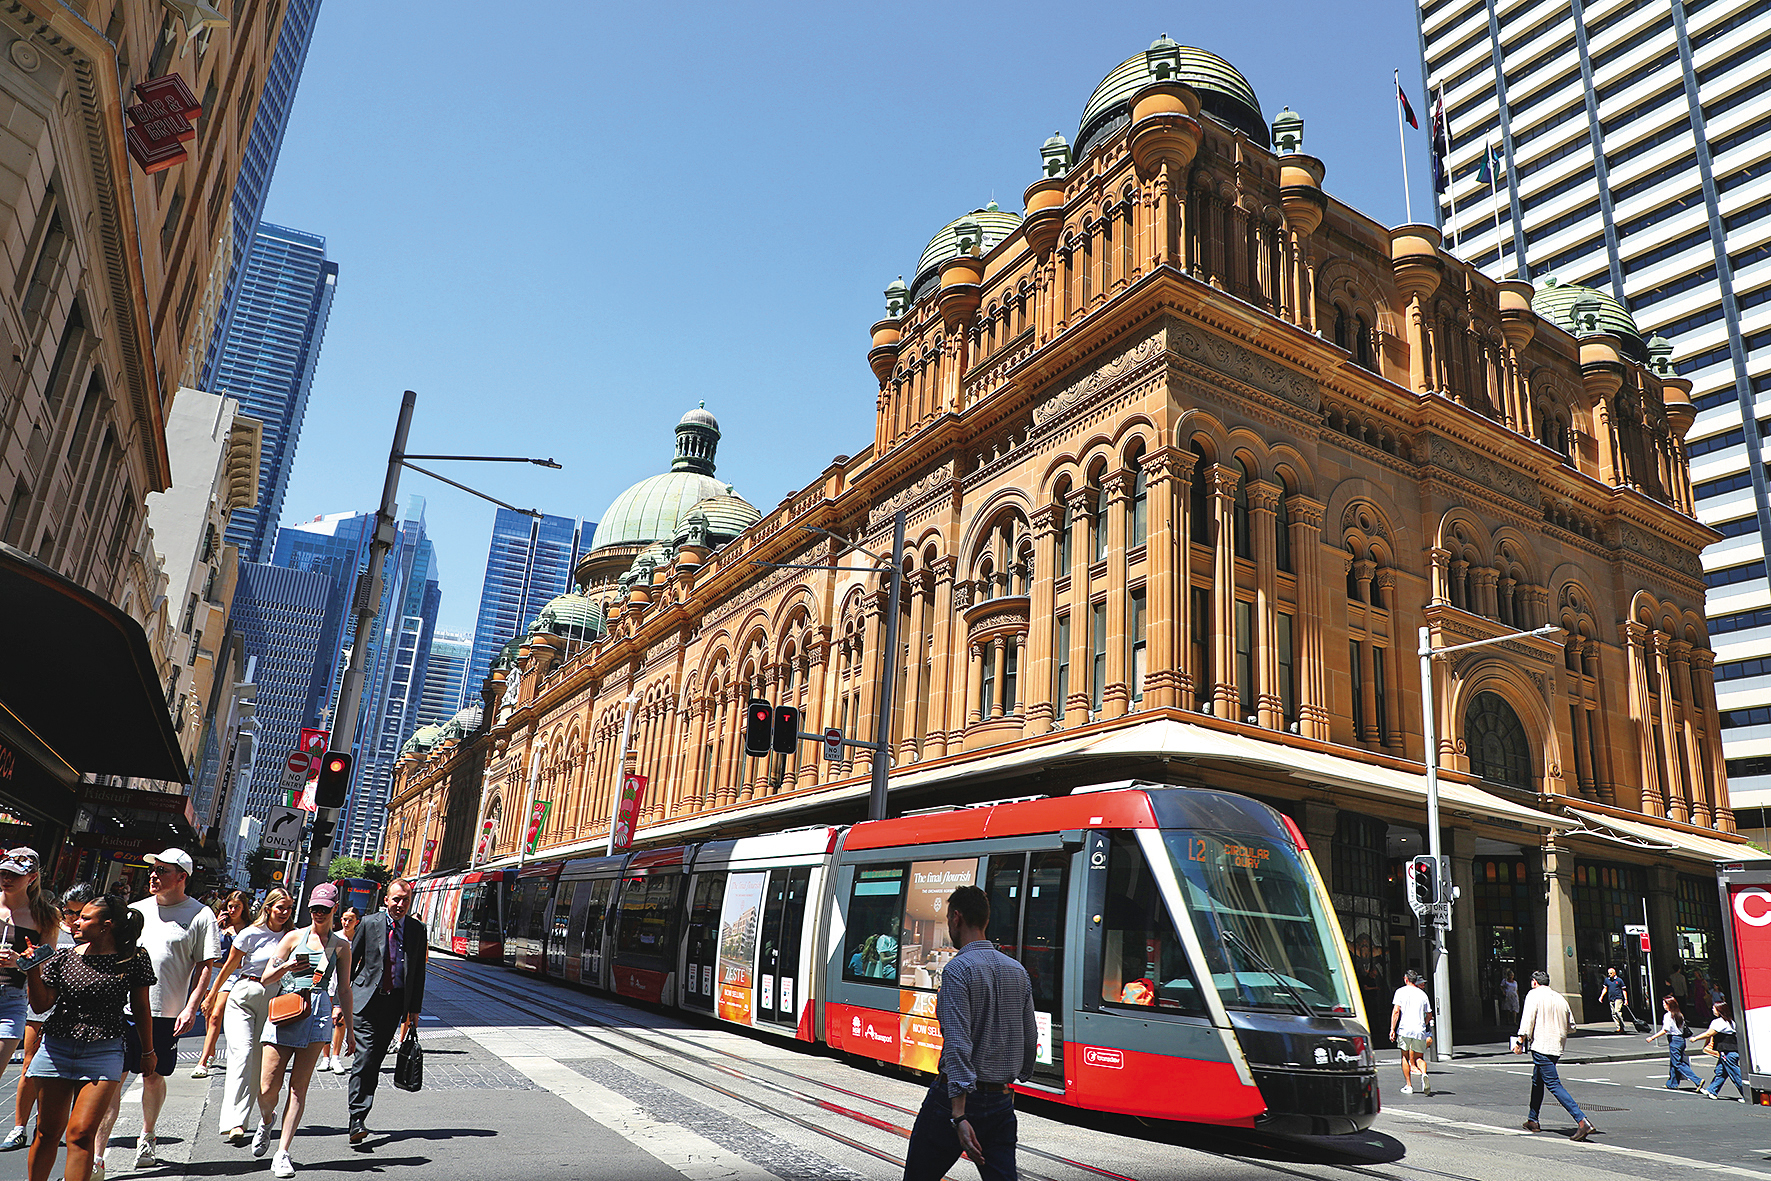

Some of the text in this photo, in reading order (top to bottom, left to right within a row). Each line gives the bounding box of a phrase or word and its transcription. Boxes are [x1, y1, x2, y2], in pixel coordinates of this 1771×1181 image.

[132, 95, 184, 123] BAR &
[144, 113, 192, 141] GRILL
[0, 744, 16, 780] CCA
[281, 780, 304, 789] ENTRY
[288, 773, 301, 781] NO
[84, 786, 133, 803] Kidstuff
[216, 760, 233, 819] GALERIES
[101, 834, 142, 847] Kidstuff
[266, 836, 294, 847] ONLY
[1188, 838, 1206, 862] L2
[1224, 844, 1270, 860] CIRCULAR
[1235, 856, 1260, 869] QUAY
[914, 870, 971, 885] The final flourish
[1433, 904, 1448, 912] ONE
[725, 966, 746, 983] ZESTE
[912, 993, 937, 1014] ZES
[912, 1023, 927, 1035] NOW
